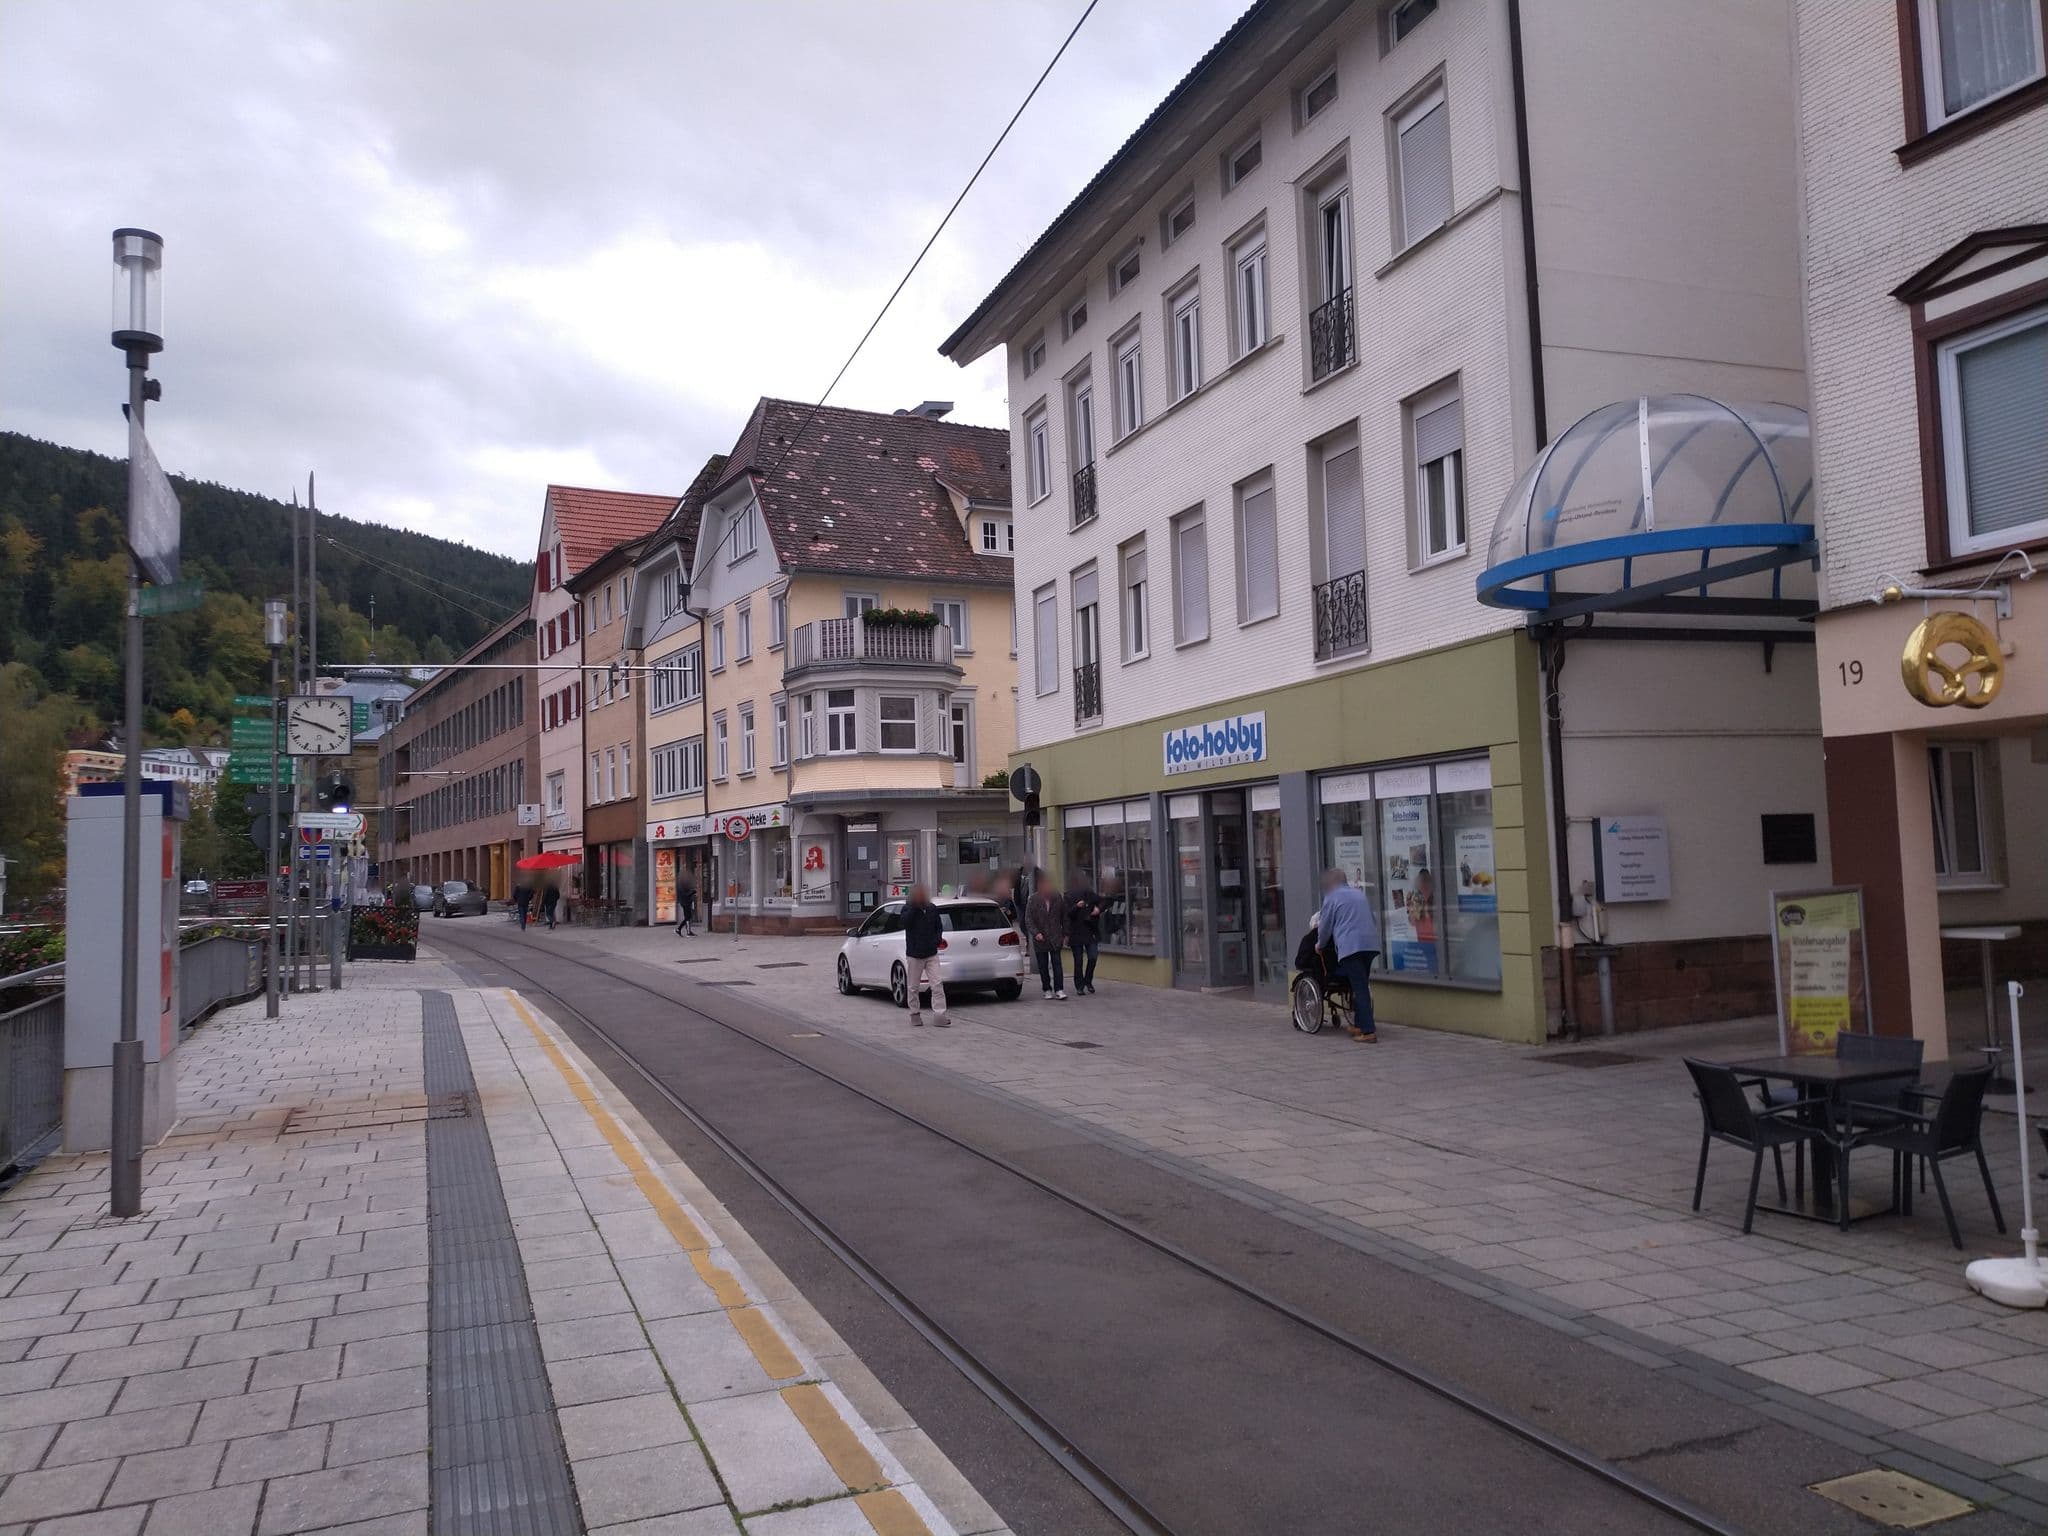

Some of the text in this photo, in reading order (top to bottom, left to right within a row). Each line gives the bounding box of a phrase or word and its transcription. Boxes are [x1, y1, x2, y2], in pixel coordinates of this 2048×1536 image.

[1839, 660, 1863, 686] 19
[1169, 754, 1250, 773] BAD WILDBAD
[682, 823, 701, 835] Apotheke
